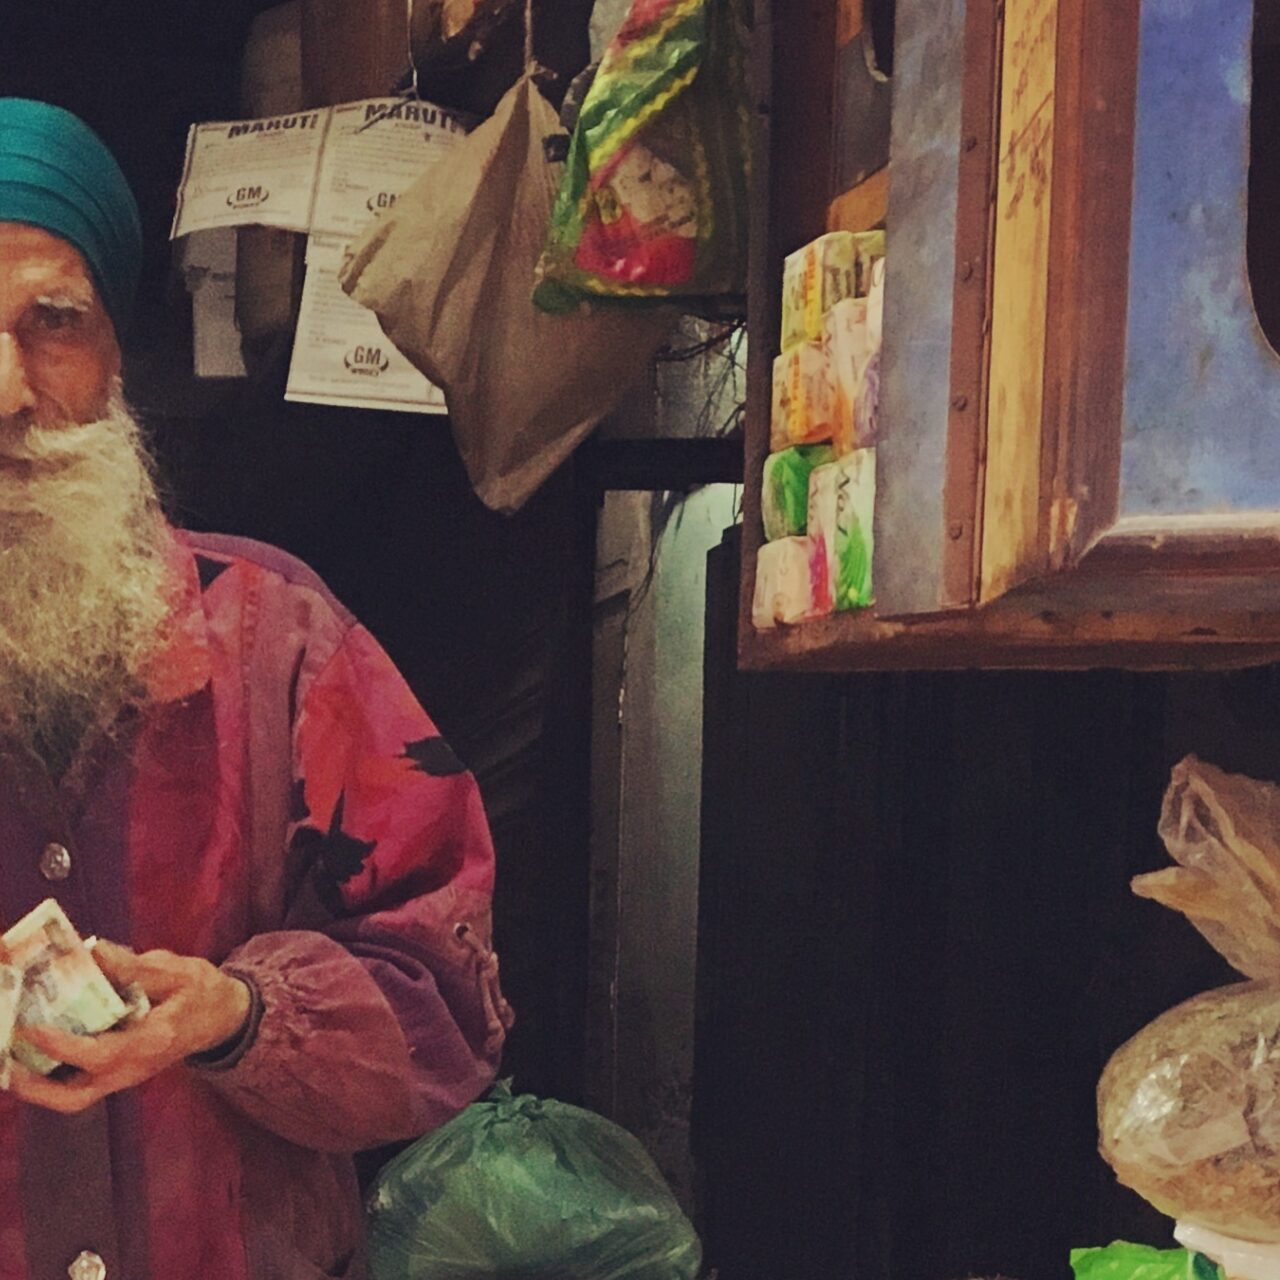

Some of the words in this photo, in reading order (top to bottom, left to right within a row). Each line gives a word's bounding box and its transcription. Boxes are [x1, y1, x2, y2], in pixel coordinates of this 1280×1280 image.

[228, 114, 319, 139] MARUTI
[365, 103, 458, 134] MARUTI
[236, 186, 262, 201] GM
[354, 345, 381, 365] GM
